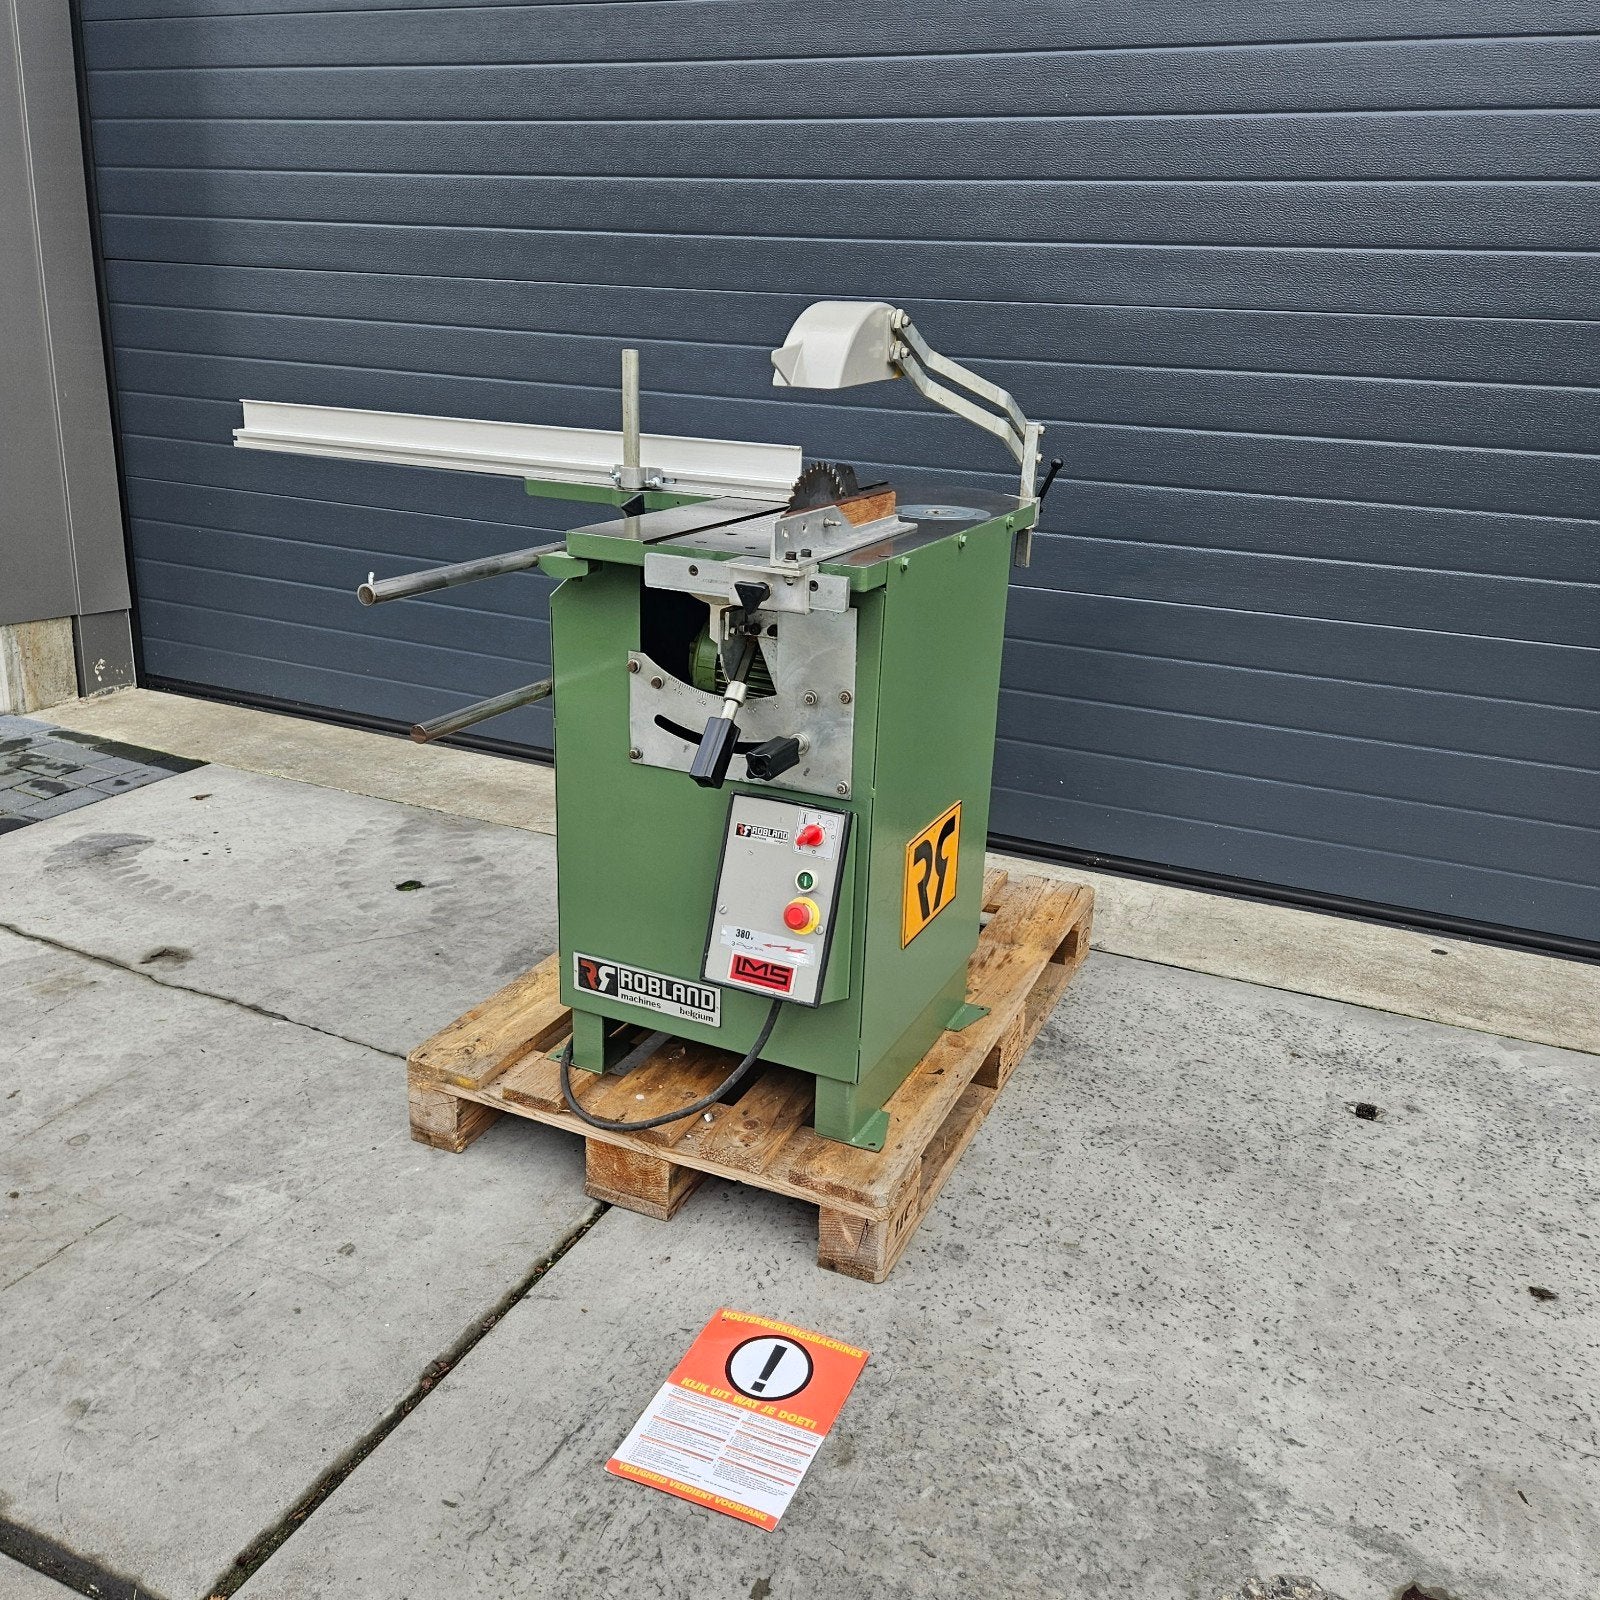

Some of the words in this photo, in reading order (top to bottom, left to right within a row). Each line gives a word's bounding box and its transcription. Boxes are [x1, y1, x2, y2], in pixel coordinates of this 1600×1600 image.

[752, 826, 789, 841] ROBLAND
[620, 968, 715, 1011] ROBLAND
[735, 957, 790, 986] LMS
[621, 992, 662, 1010] machines
[679, 1006, 714, 1023] belgium
[721, 1310, 863, 1359] HOUTBEWERKINGSMACHINES
[680, 1378, 710, 1393] KIJK
[710, 1387, 732, 1400] UIT
[732, 1394, 761, 1409] WAT
[761, 1404, 777, 1416] JE
[777, 1409, 818, 1430] DOET!
[618, 1462, 668, 1485] VEILIGHEID
[669, 1480, 715, 1501] VERDIENT
[715, 1496, 769, 1522] VOORRANG
